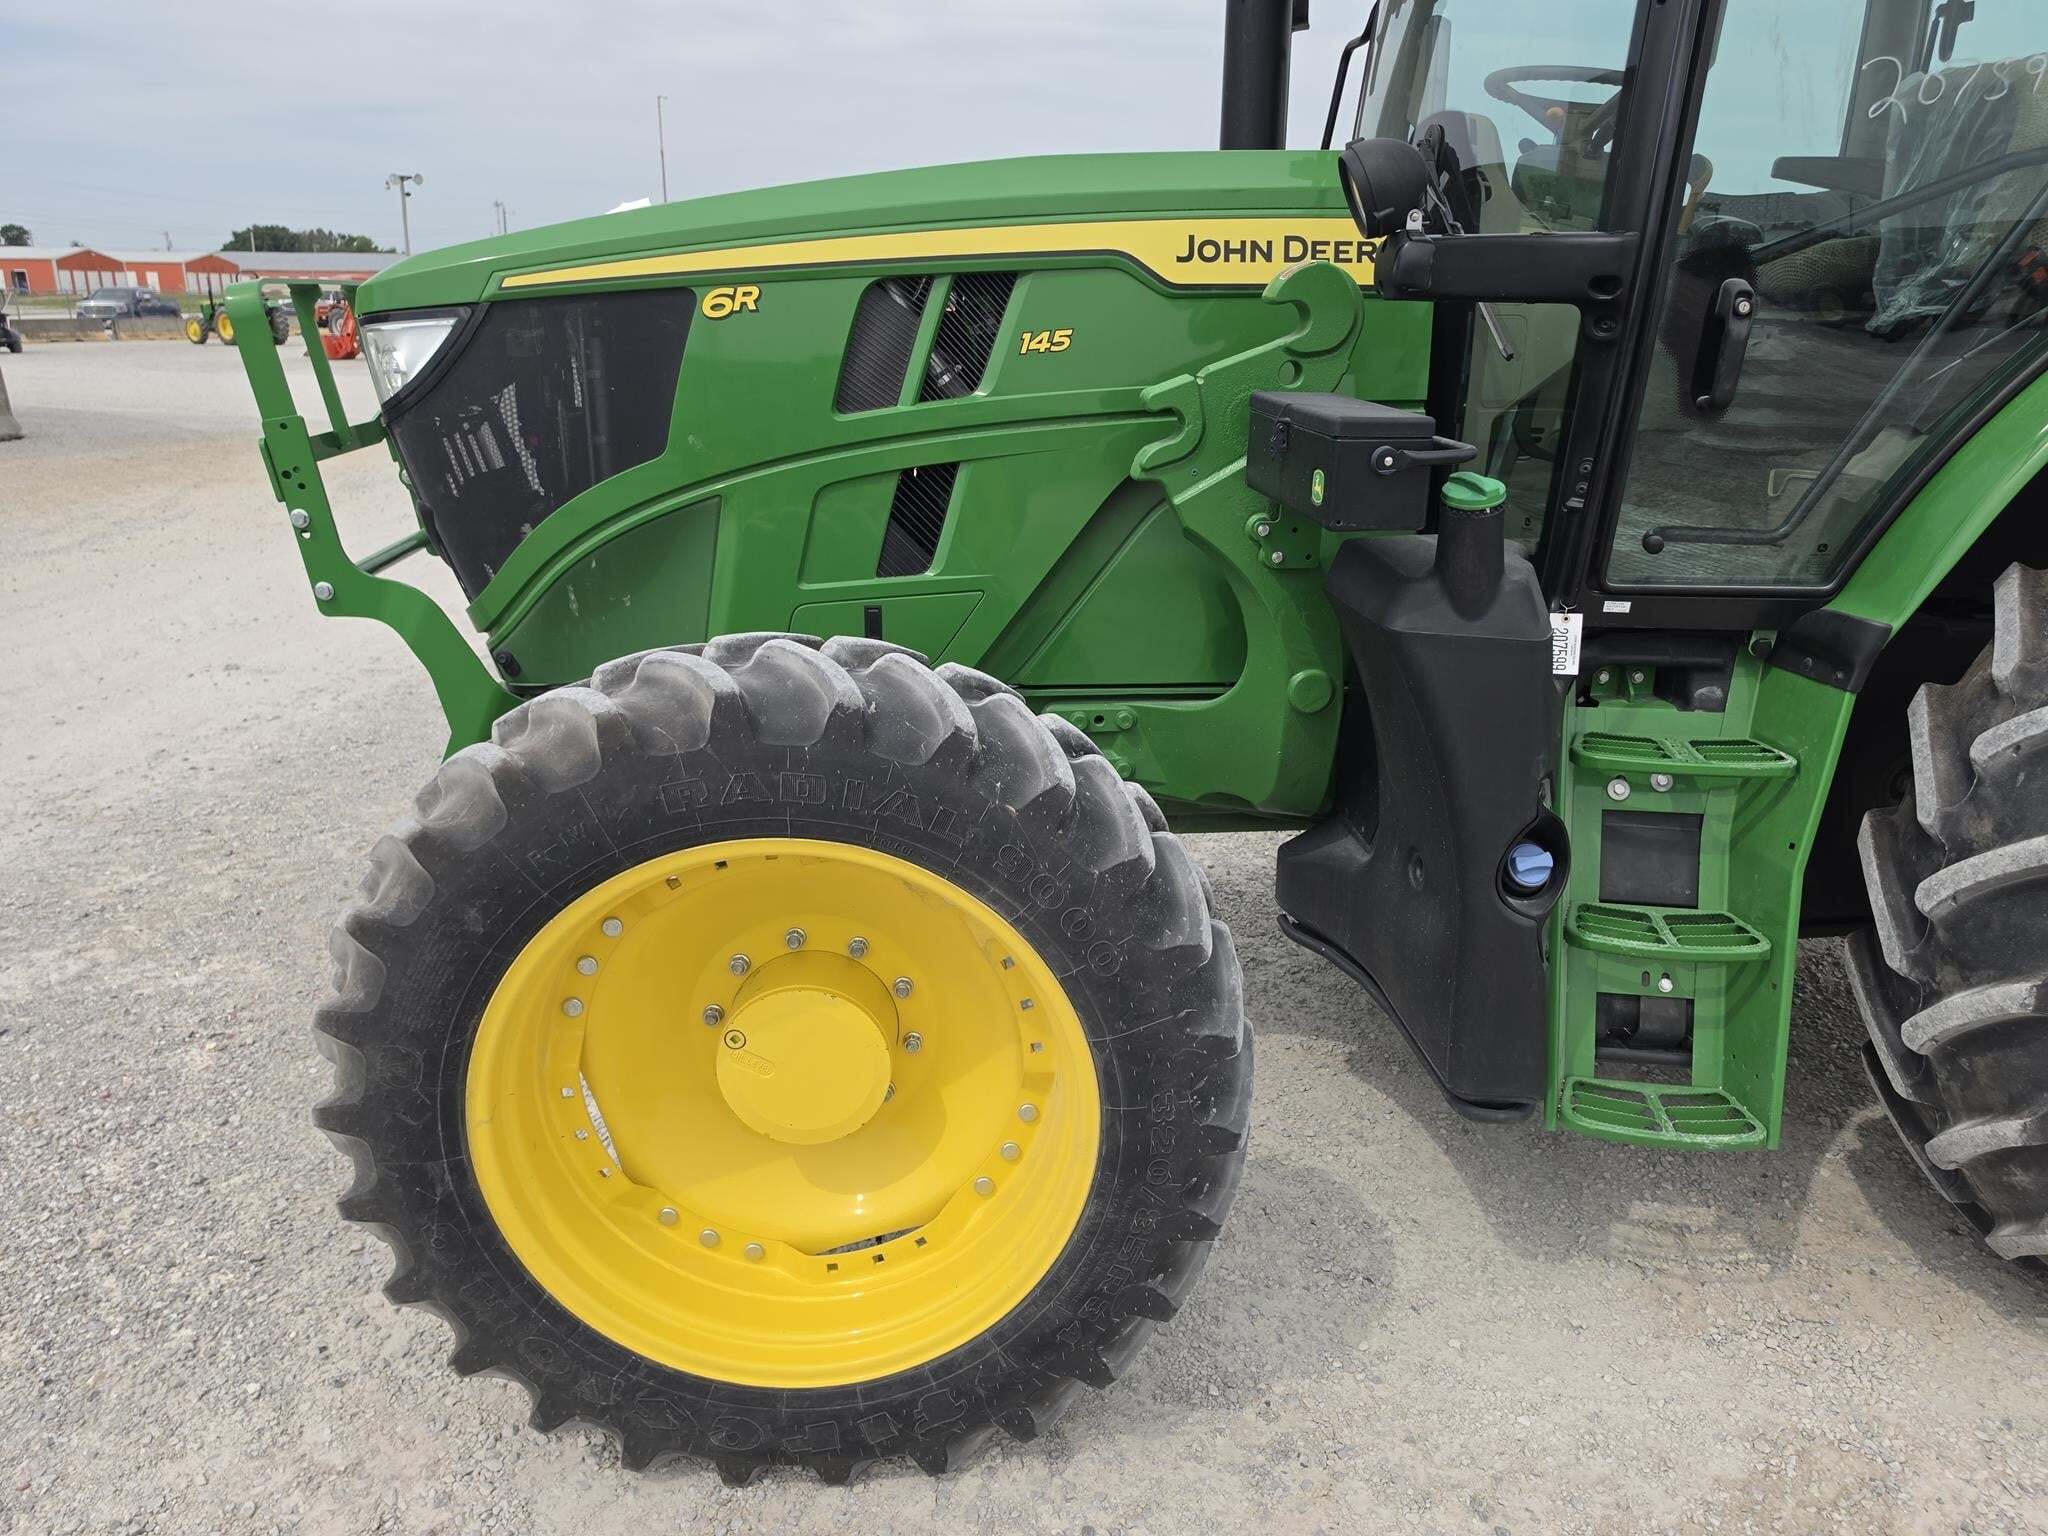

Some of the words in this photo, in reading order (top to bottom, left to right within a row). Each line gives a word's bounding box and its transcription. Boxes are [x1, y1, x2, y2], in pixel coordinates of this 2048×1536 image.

[1176, 234, 1273, 263] JOHN
[1283, 235, 1376, 263] DEER
[702, 284, 762, 320] 6R
[1019, 328, 1074, 355] 145
[1552, 627, 1569, 671] 207599
[659, 771, 965, 851] RADIAL
[993, 844, 1122, 977] 9000
